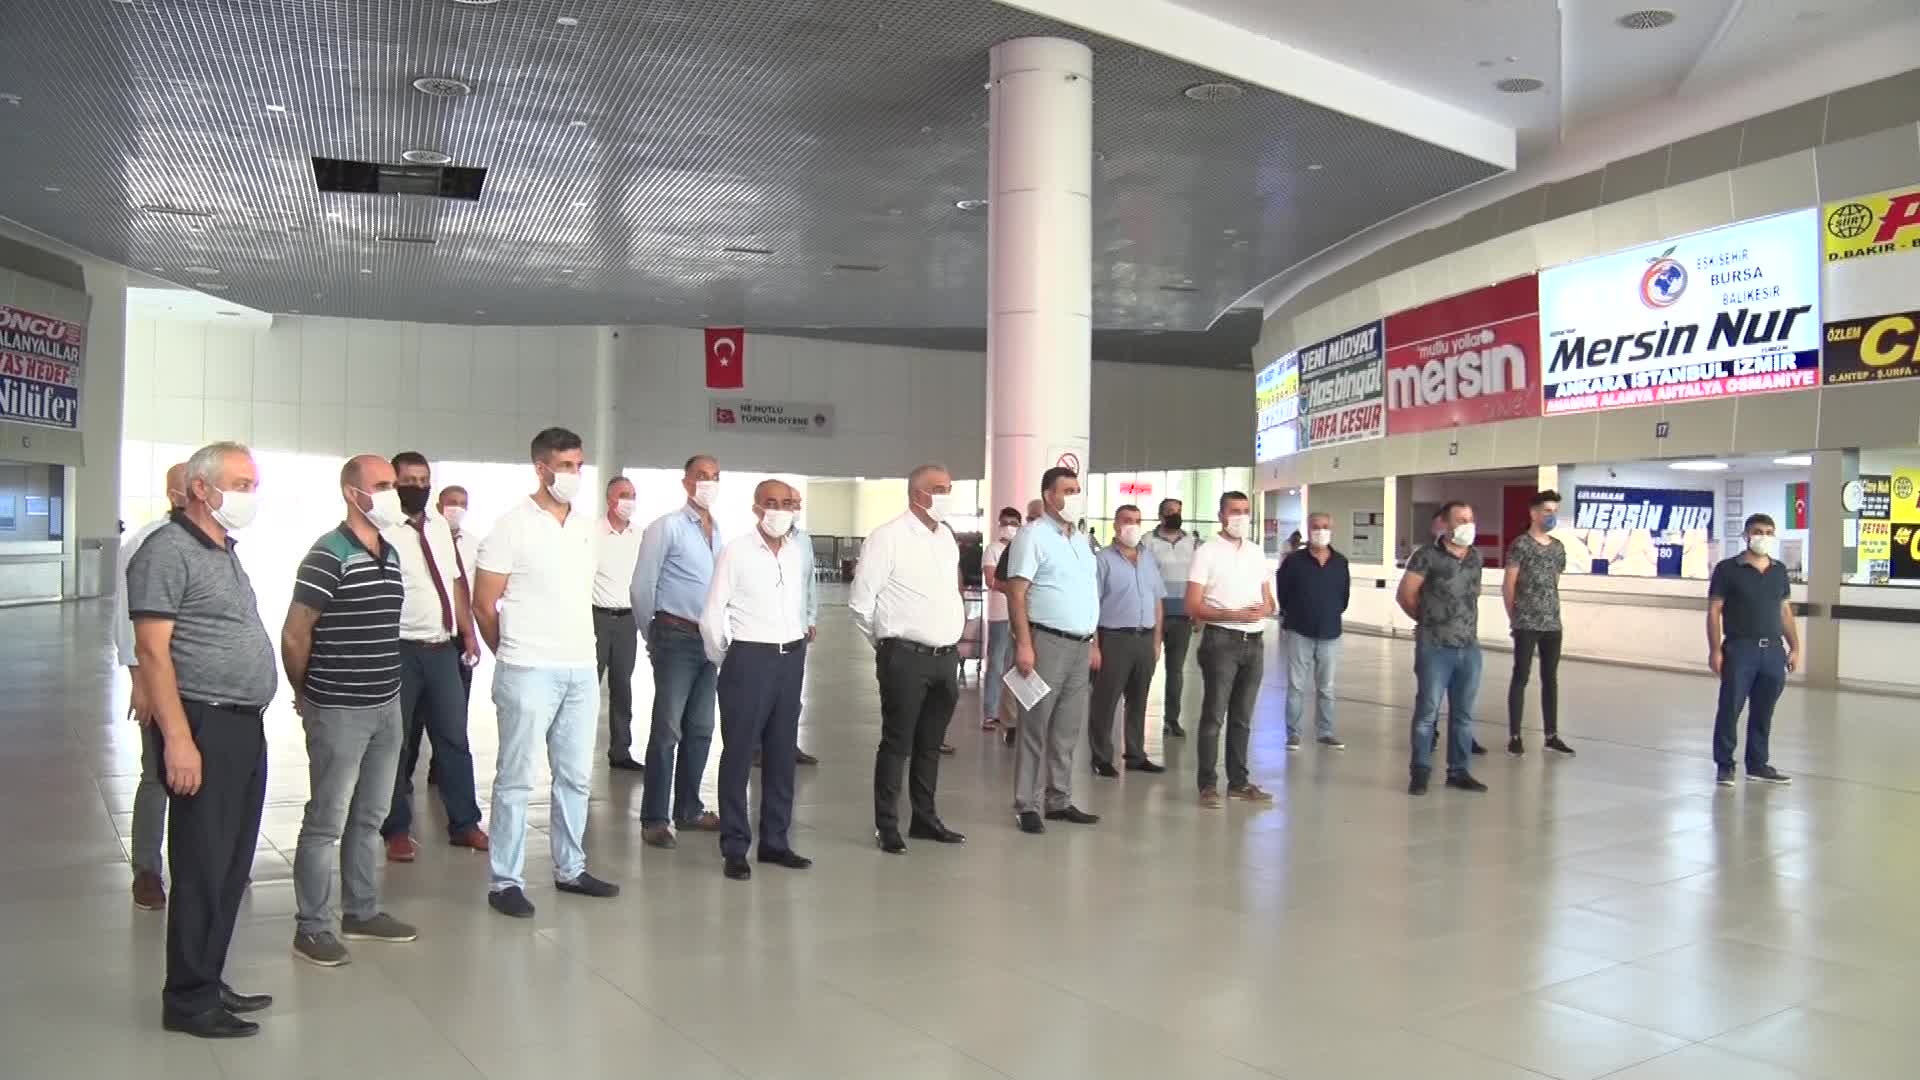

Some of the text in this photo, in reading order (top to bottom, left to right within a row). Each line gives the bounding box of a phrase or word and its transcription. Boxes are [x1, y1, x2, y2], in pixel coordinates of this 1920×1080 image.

[1711, 266, 1763, 286] BURSA
[1707, 304, 1812, 351] Nur
[1827, 326, 1862, 343] ÖZLEM
[26, 359, 70, 384] HEDEF
[1310, 414, 1337, 440] URFA
[1340, 404, 1382, 432] CESUR
[1667, 506, 1713, 531] NUR
